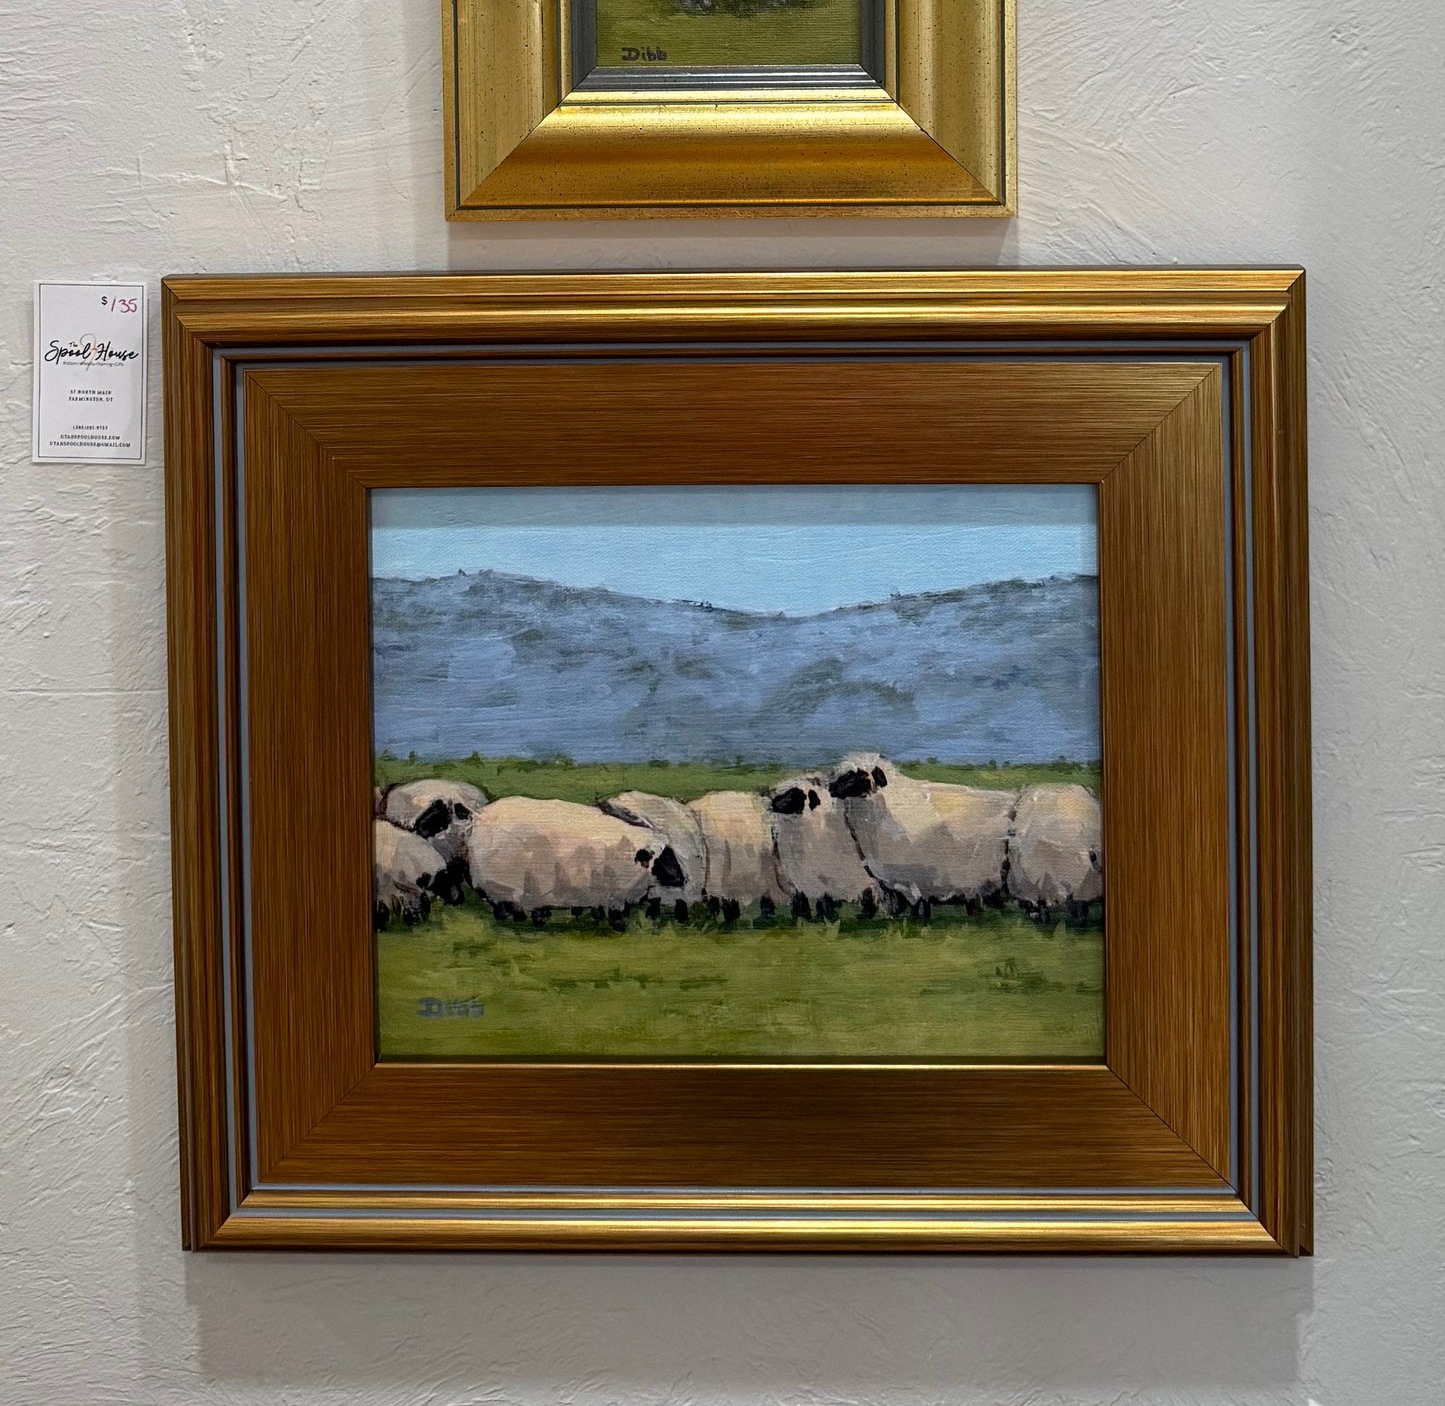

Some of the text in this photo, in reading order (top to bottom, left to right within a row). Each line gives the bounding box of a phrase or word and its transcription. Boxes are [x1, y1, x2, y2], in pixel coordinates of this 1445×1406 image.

[621, 46, 667, 61] Dibb
[44, 340, 139, 365] Spool House
